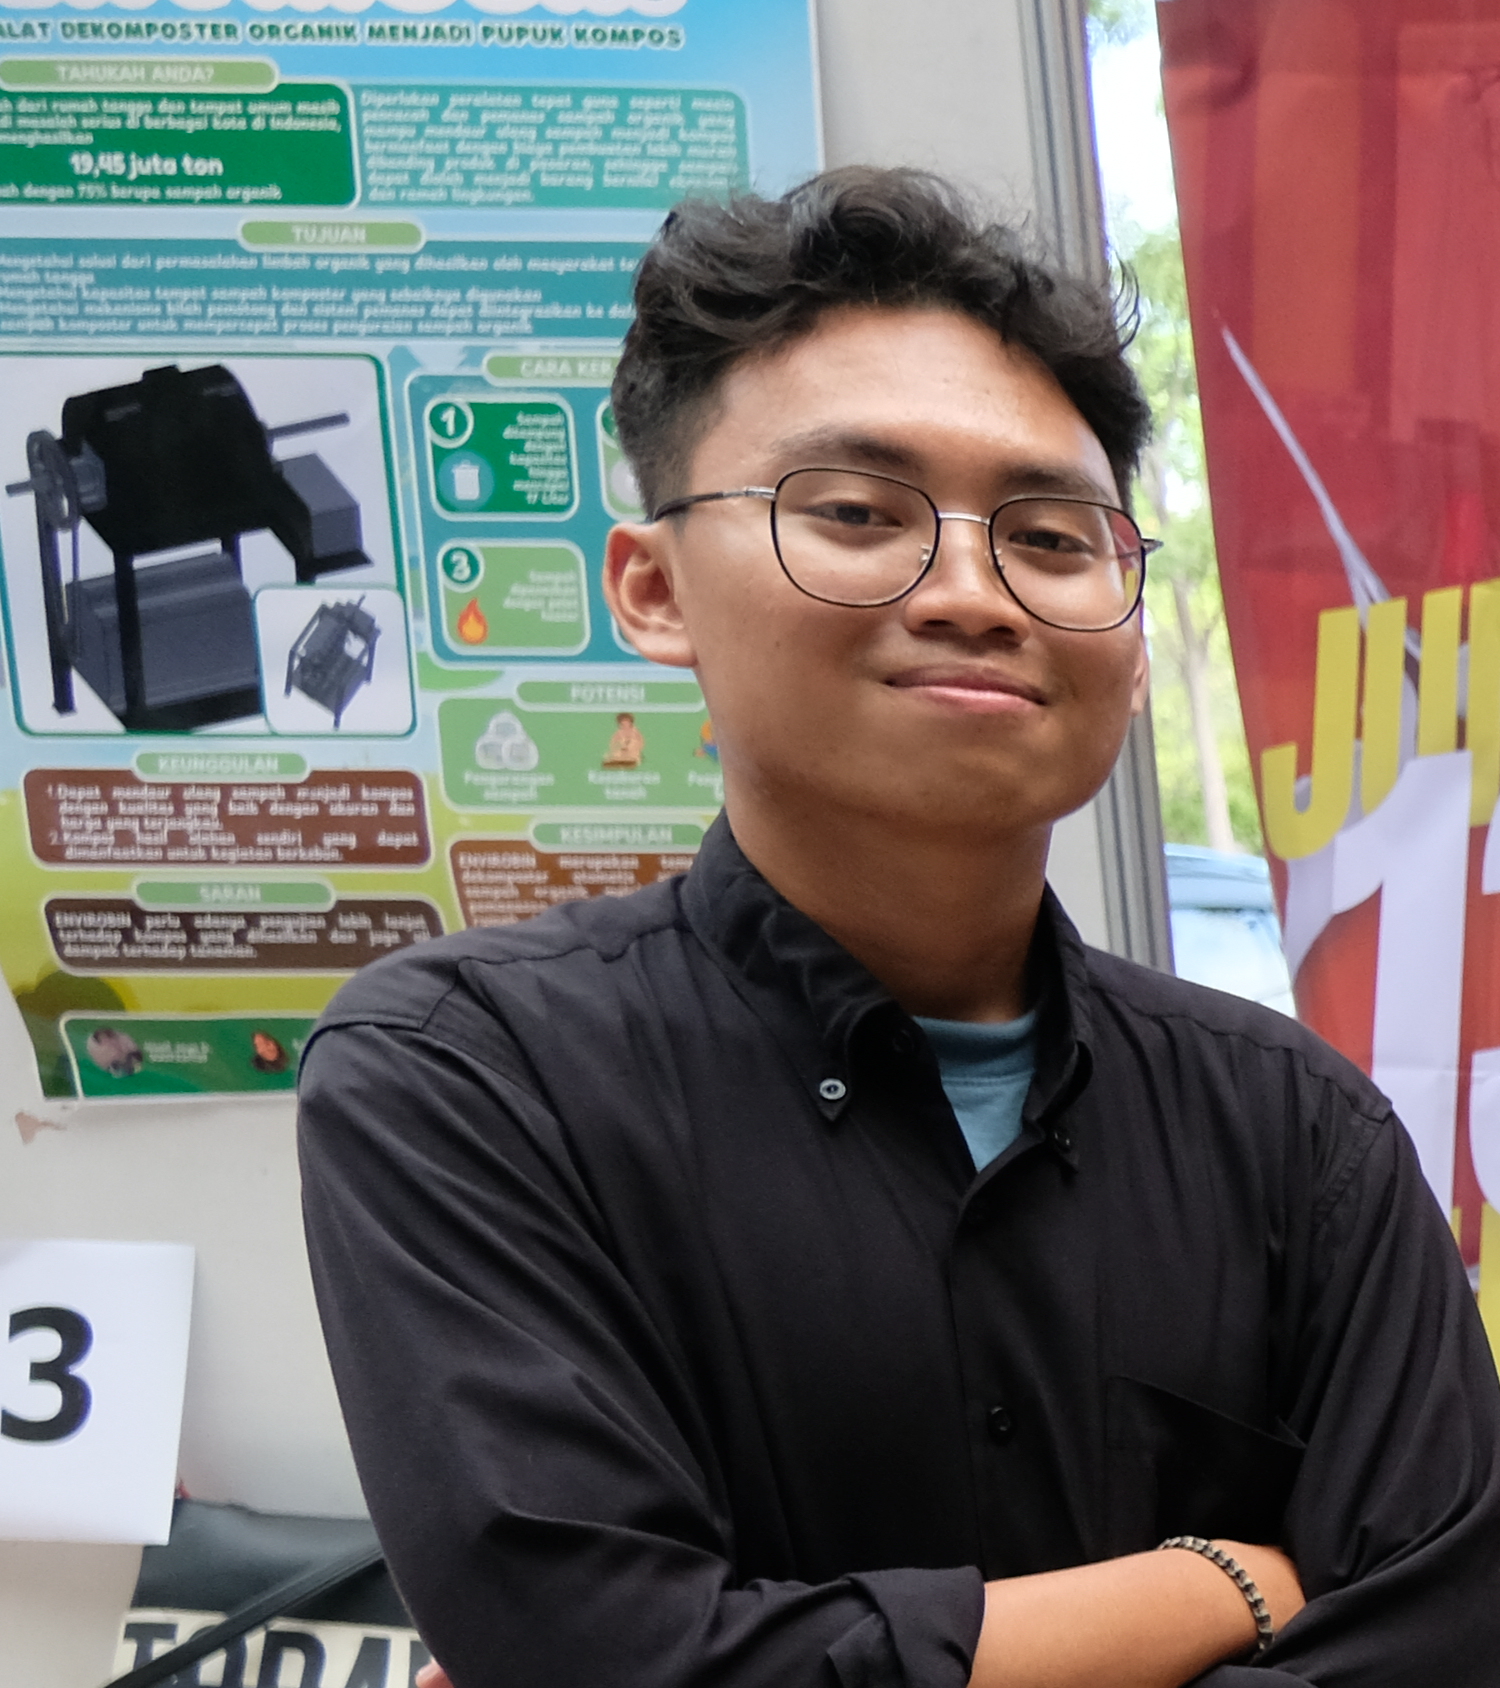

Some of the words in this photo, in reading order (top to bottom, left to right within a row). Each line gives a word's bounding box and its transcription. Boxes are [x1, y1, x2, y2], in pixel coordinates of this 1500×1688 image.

[60, 21, 239, 40] DEKOMPOSTER
[249, 22, 358, 41] ORGANIK
[367, 24, 471, 42] MENJADI
[481, 25, 563, 43] PUPUK
[574, 27, 682, 46] KOMPOS
[56, 64, 146, 82] TAHUKAH
[152, 64, 215, 83] ANDA?
[69, 151, 126, 178] 19,45
[129, 152, 177, 181] juta
[181, 153, 224, 176] ton
[291, 224, 366, 243] TUJUAN
[441, 405, 456, 436] 1
[451, 550, 472, 582] 3
[570, 684, 646, 702] POTENSI
[157, 754, 279, 774] KEUNGGULAN
